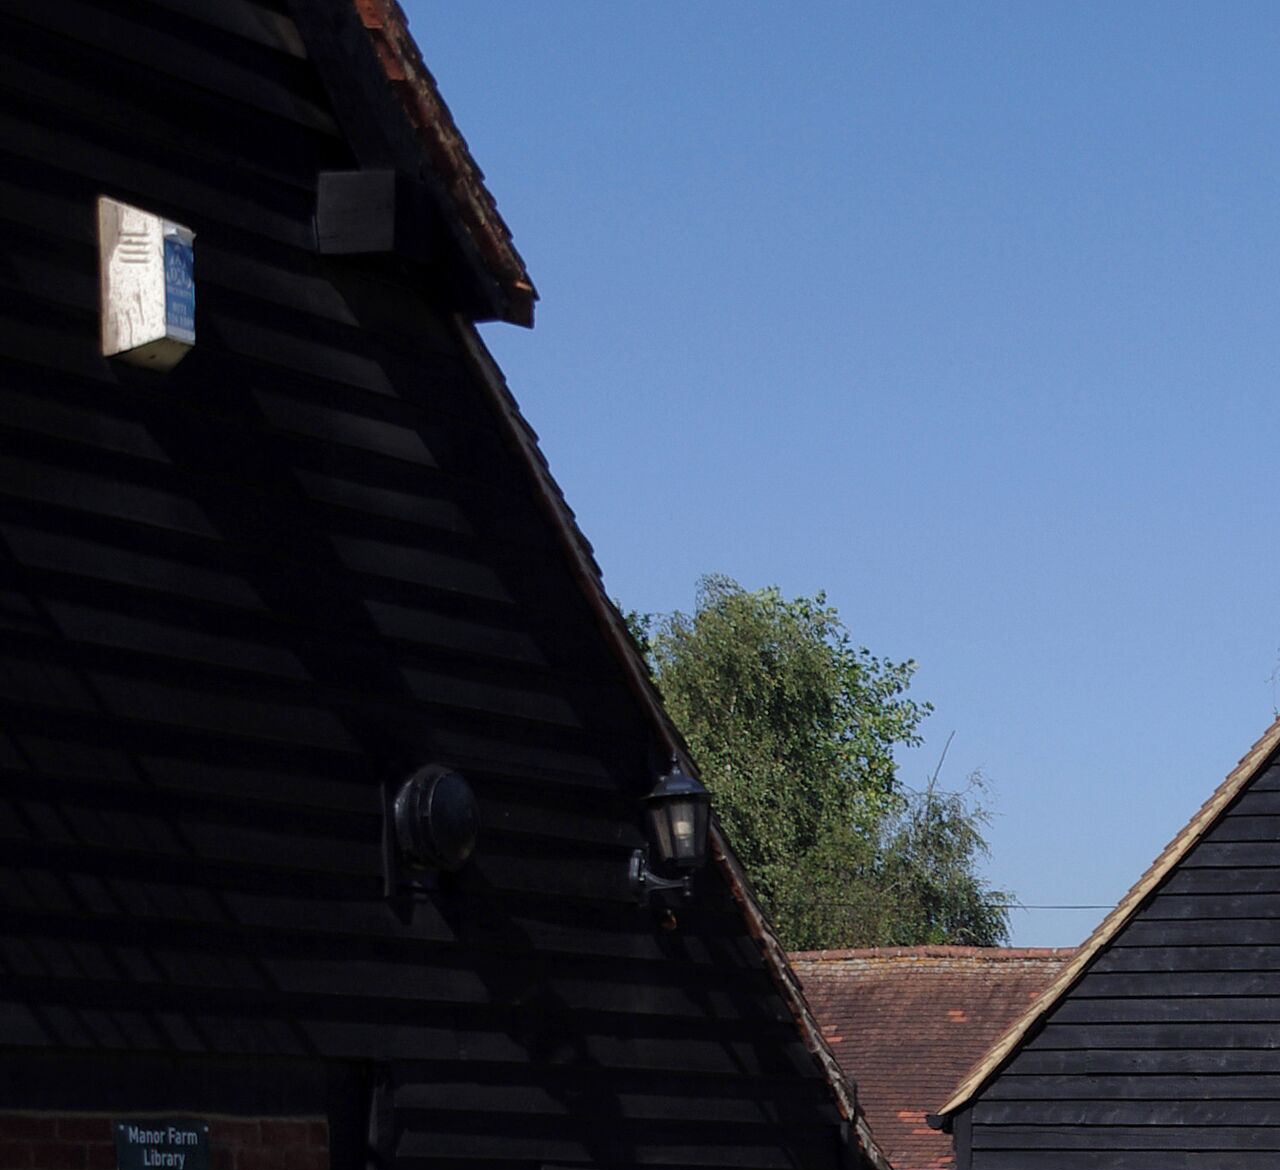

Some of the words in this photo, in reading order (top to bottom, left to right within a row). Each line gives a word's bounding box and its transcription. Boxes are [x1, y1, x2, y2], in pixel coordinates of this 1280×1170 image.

[128, 1125, 166, 1144] Manor
[168, 1127, 198, 1145] Farm
[143, 1149, 185, 1170] Library
